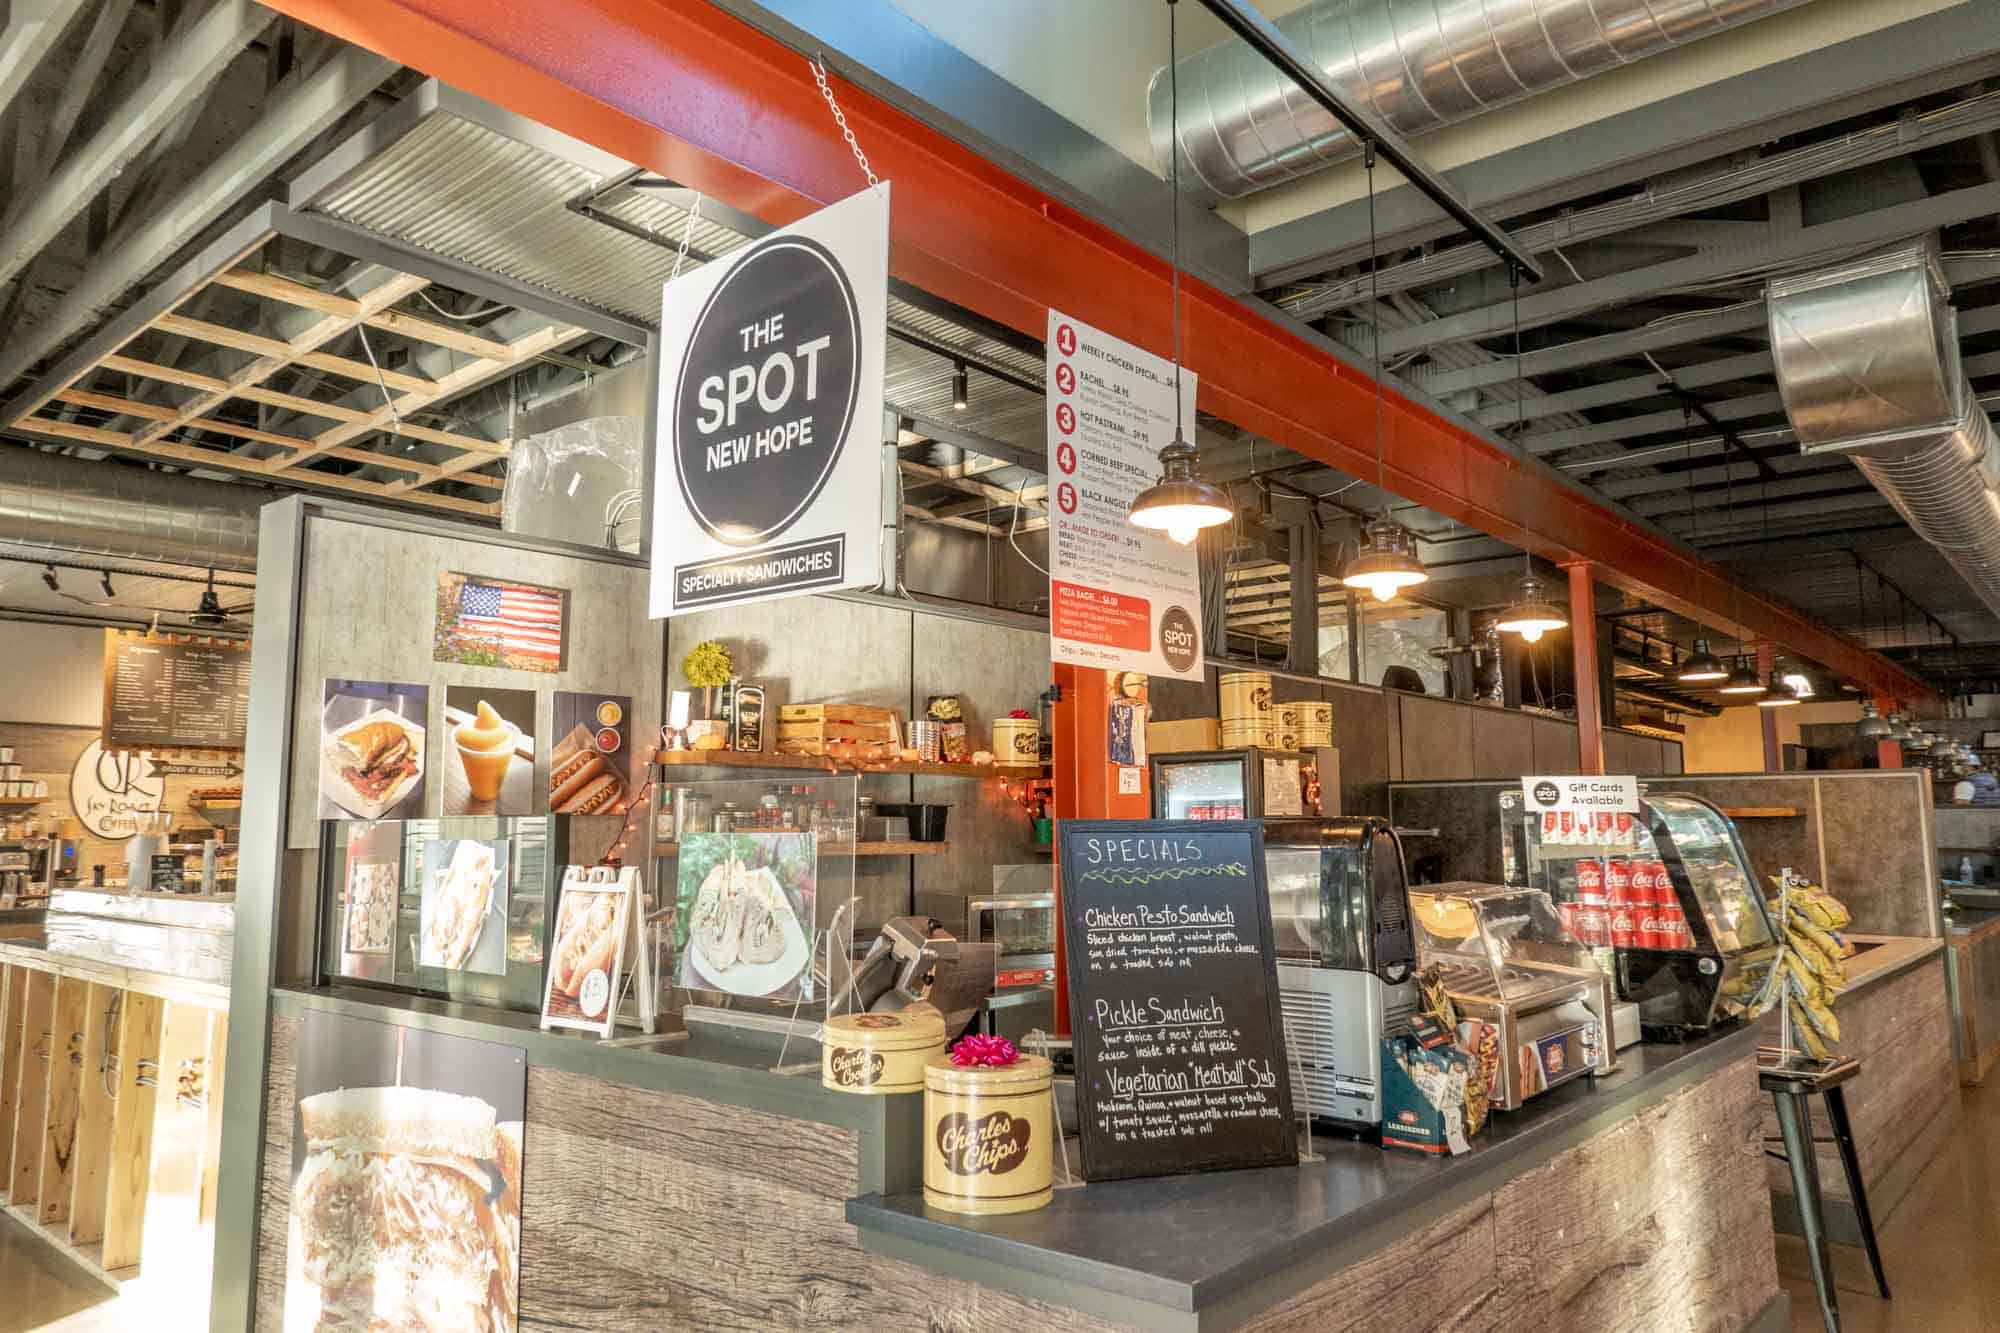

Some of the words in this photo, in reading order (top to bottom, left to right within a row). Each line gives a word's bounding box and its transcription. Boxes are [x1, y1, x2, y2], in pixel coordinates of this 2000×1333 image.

[740, 313, 785, 353] THE
[1061, 327, 1072, 354] 1
[1081, 343, 1104, 360] WEEKLY
[1106, 354, 1134, 371] CHICKEN
[696, 335, 830, 434] SPOT
[1059, 366, 1072, 391] 2
[1059, 407, 1072, 431] 3
[1080, 409, 1094, 423] HOT
[706, 436, 752, 472] NEW
[755, 416, 813, 458] HOPE
[1060, 446, 1072, 471] 4
[1080, 448, 1108, 466] CORNED
[1109, 458, 1123, 471] BEEF
[1060, 486, 1073, 510] 5
[1082, 487, 1102, 502] BLACK
[1104, 494, 1126, 509] ANGUS
[682, 566, 744, 595] SPECIALTY
[746, 550, 833, 584] SANDWICHES
[1164, 630, 1192, 647] SPOT
[1569, 783, 1588, 792] Gift
[1590, 783, 1624, 792] Cards
[1572, 796, 1624, 805] Available
[1087, 838, 1202, 864] SPECIALS
[1086, 905, 1138, 928] Chicken
[1136, 904, 1178, 925] Pesto
[1178, 904, 1235, 925] Sandwich
[1096, 998, 1148, 1028] Pickle
[1148, 996, 1224, 1024] Sandwich
[1124, 1031, 1153, 1044] choice
[1156, 1028, 1166, 1040] of
[1098, 1050, 1129, 1062] sauce
[1134, 1044, 1163, 1057] inside
[1166, 1042, 1176, 1055] of
[1180, 1045, 1188, 1054] a
[1192, 1040, 1206, 1054] dill
[1208, 1040, 1238, 1056] pickle
[1106, 1065, 1188, 1100] Vegetarian
[1248, 1058, 1276, 1088] Sub
[1204, 1093, 1227, 1105] based
[942, 1118, 1011, 1153] Charles
[1116, 1132, 1127, 1141] on
[1130, 1130, 1137, 1140] a
[1142, 1124, 1176, 1140] toasted
[963, 1140, 1020, 1171] Chips
